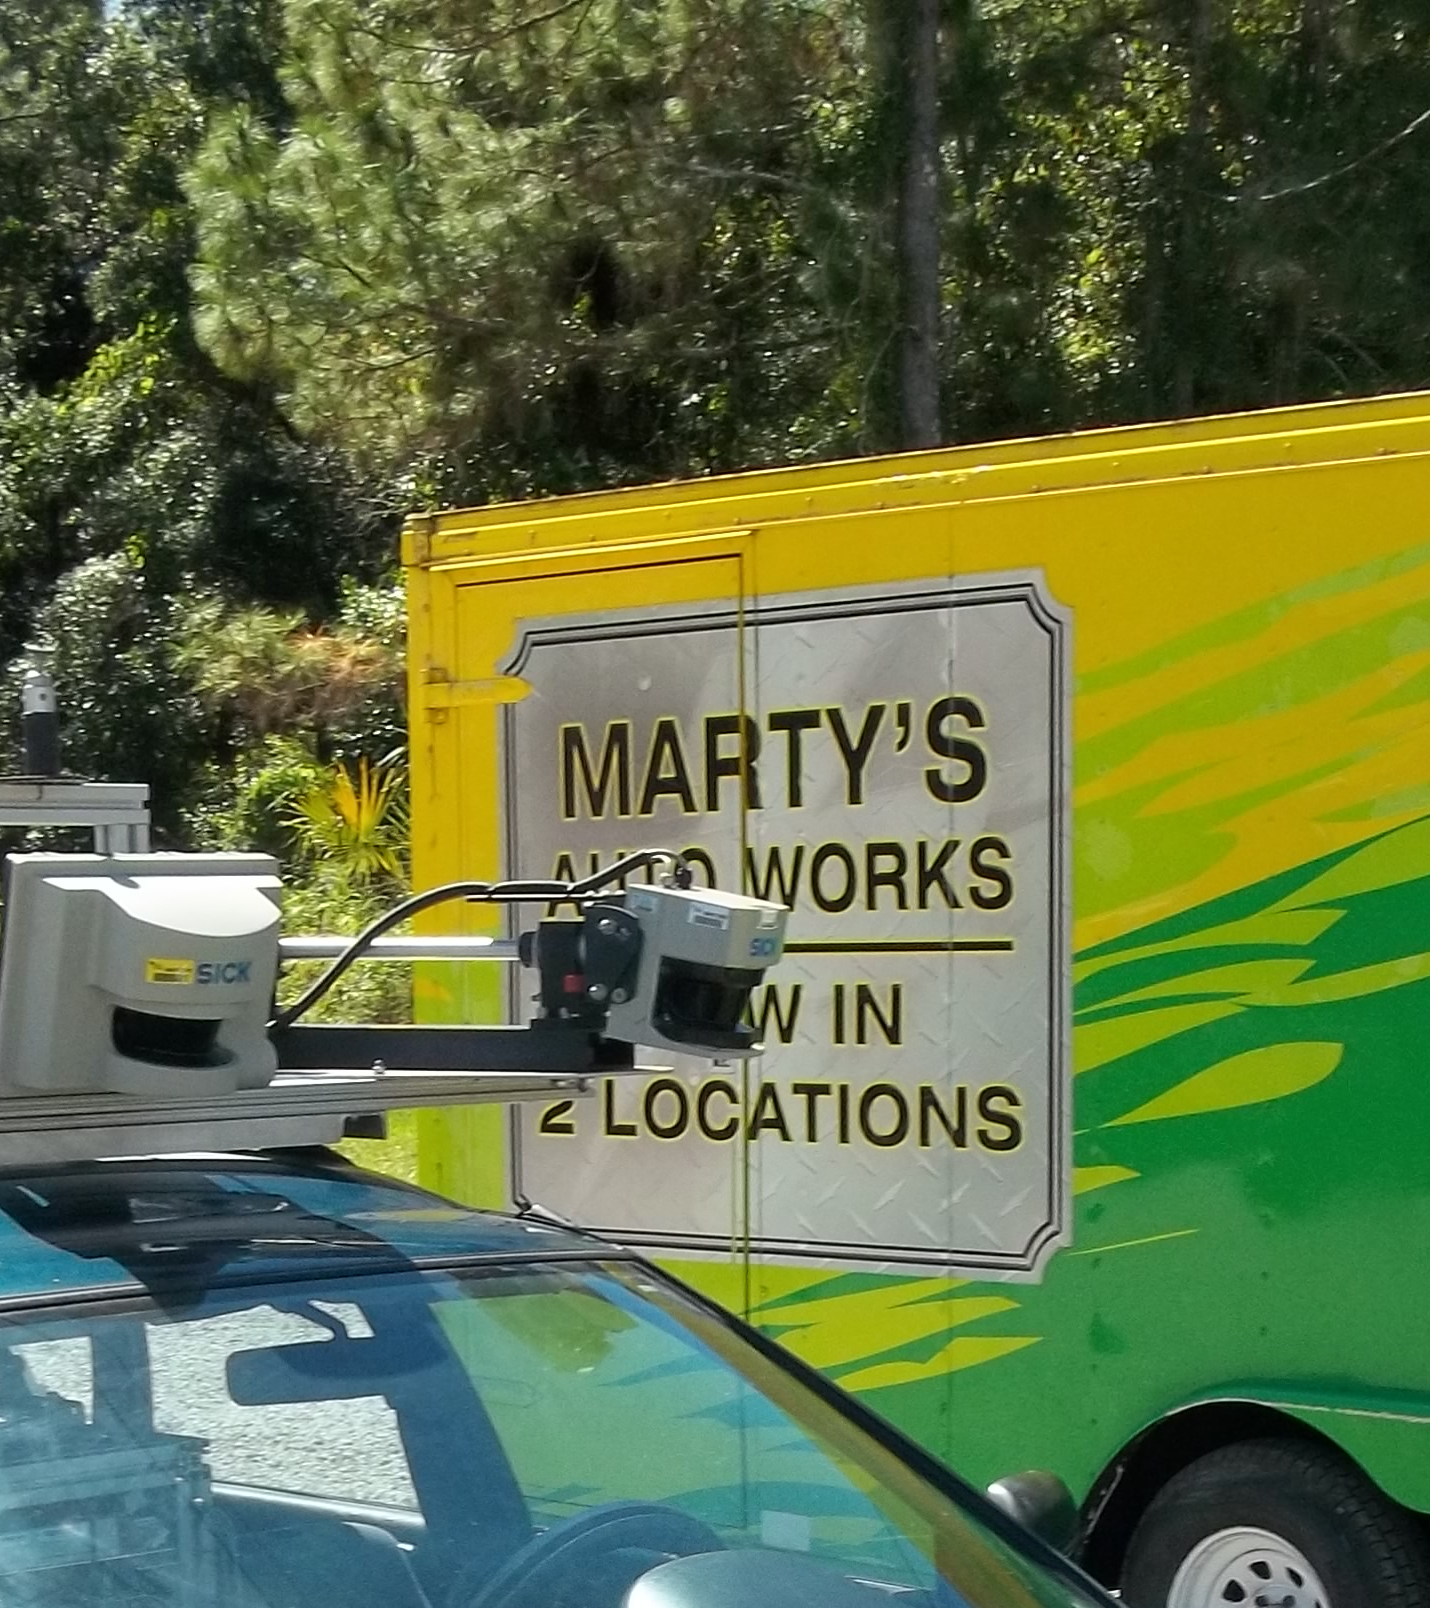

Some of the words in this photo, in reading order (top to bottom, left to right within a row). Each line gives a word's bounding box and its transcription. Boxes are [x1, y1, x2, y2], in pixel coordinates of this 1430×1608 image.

[559, 696, 988, 820] MARTY'S
[743, 836, 1015, 912] WORKS
[197, 960, 252, 985] SICK
[832, 983, 904, 1046] IN
[604, 1076, 1025, 1153] LOCATIONS
